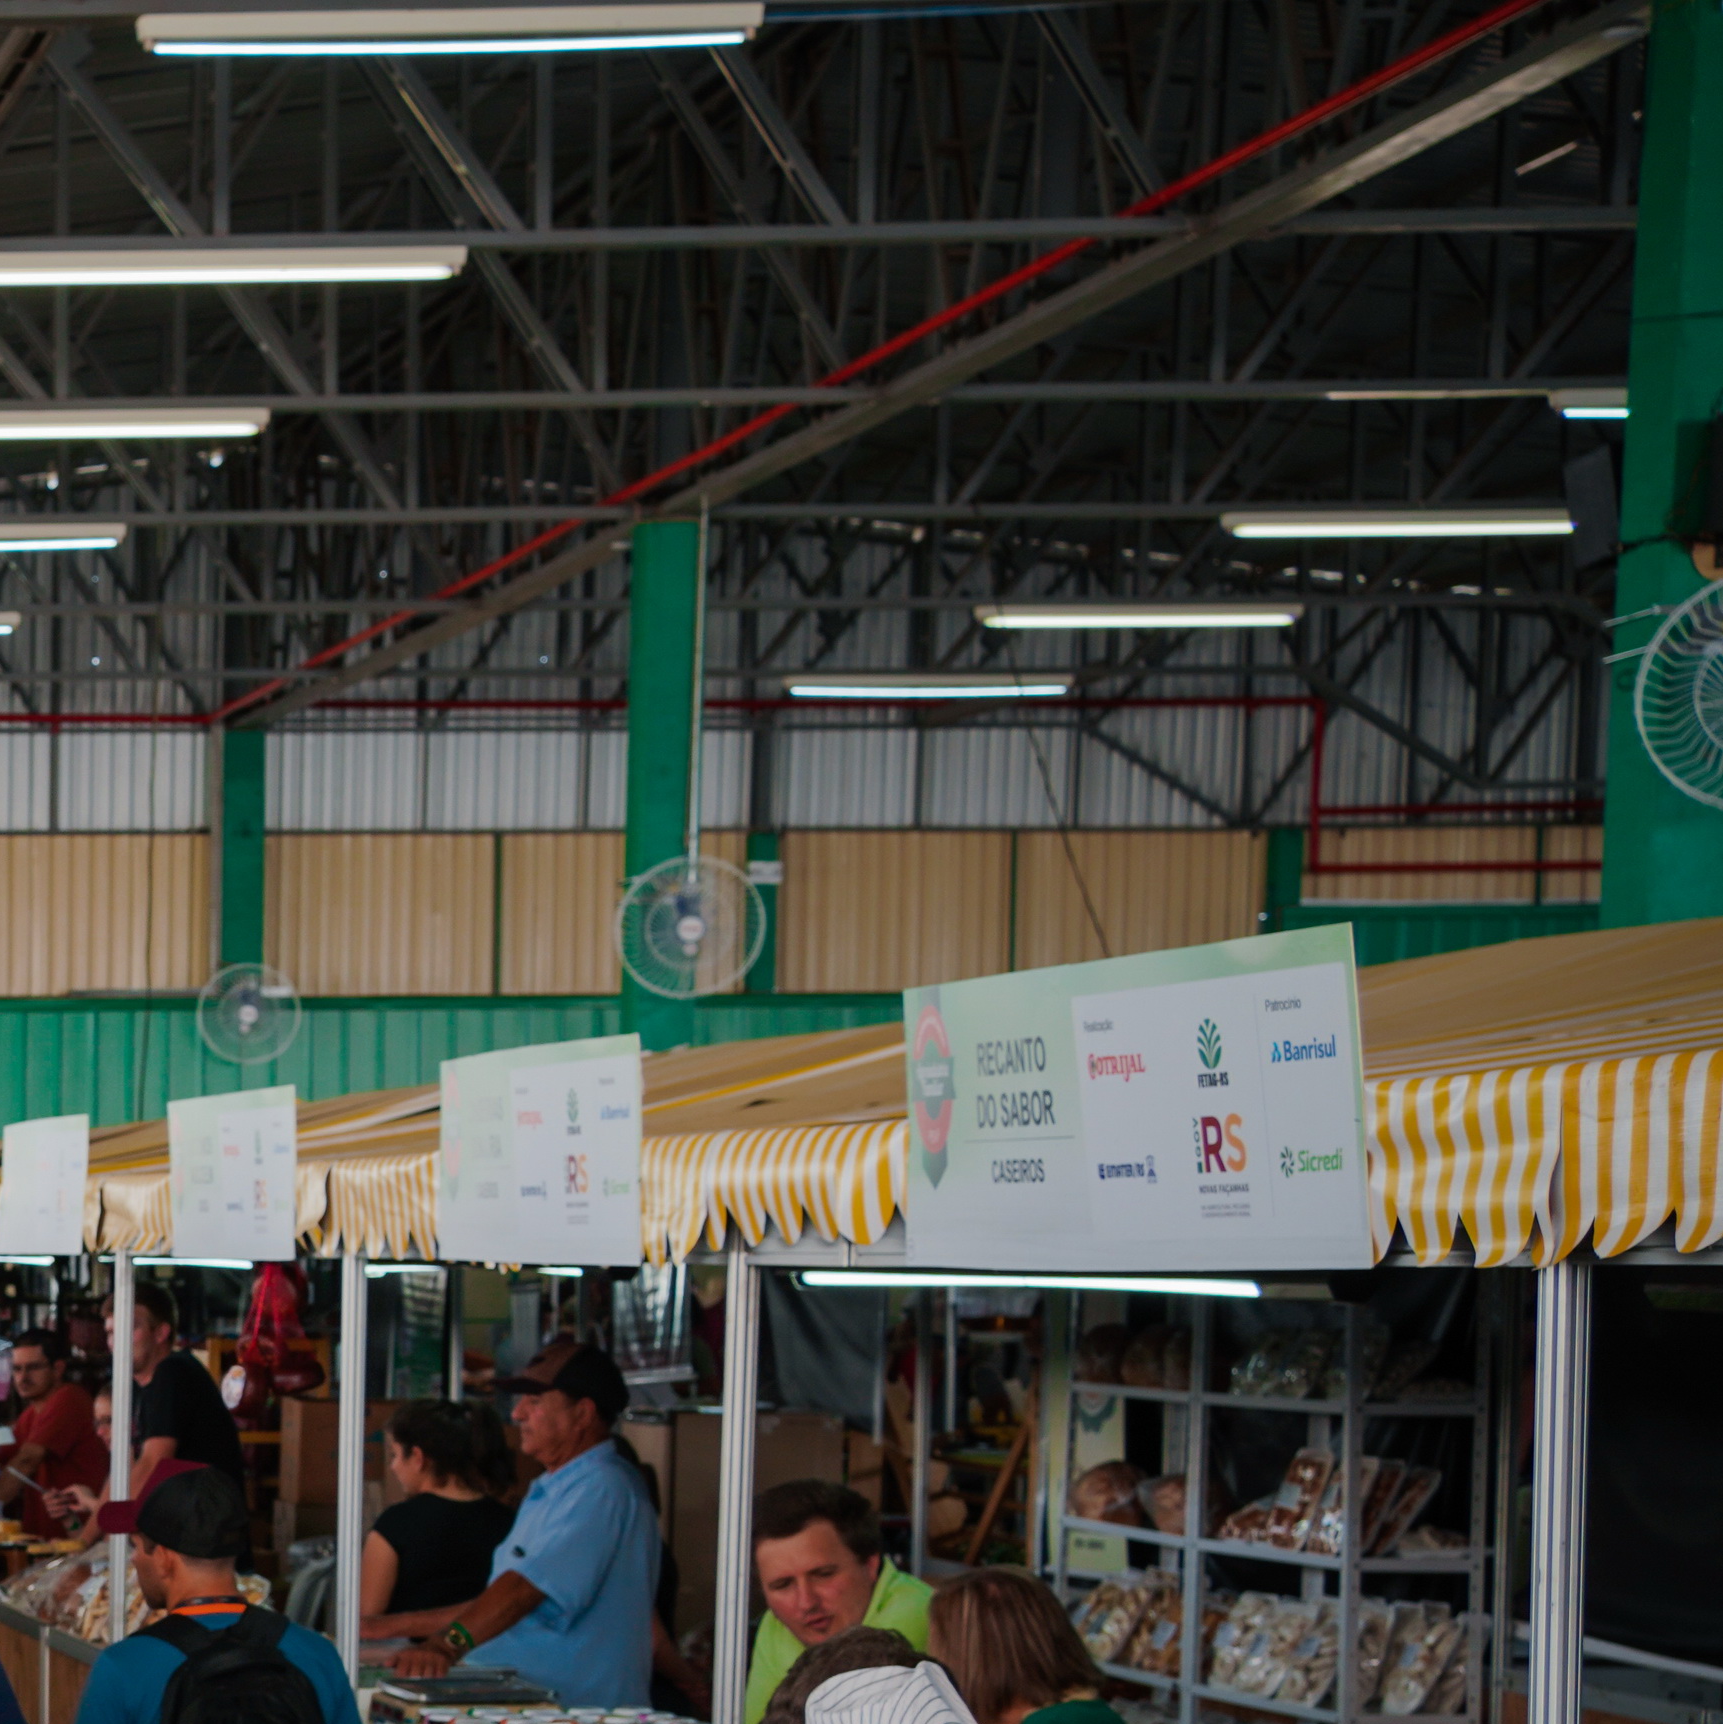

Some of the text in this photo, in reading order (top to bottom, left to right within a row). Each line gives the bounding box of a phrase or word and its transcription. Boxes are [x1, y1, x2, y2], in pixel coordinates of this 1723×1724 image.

[976, 1036, 1046, 1077] RECANTO
[1283, 1034, 1336, 1062] Banrisul
[976, 1090, 1056, 1129] DO SABOR
[1201, 1113, 1247, 1173] RS
[991, 1158, 1045, 1183] CASEIROS
[1298, 1147, 1343, 1173] Sicredi
